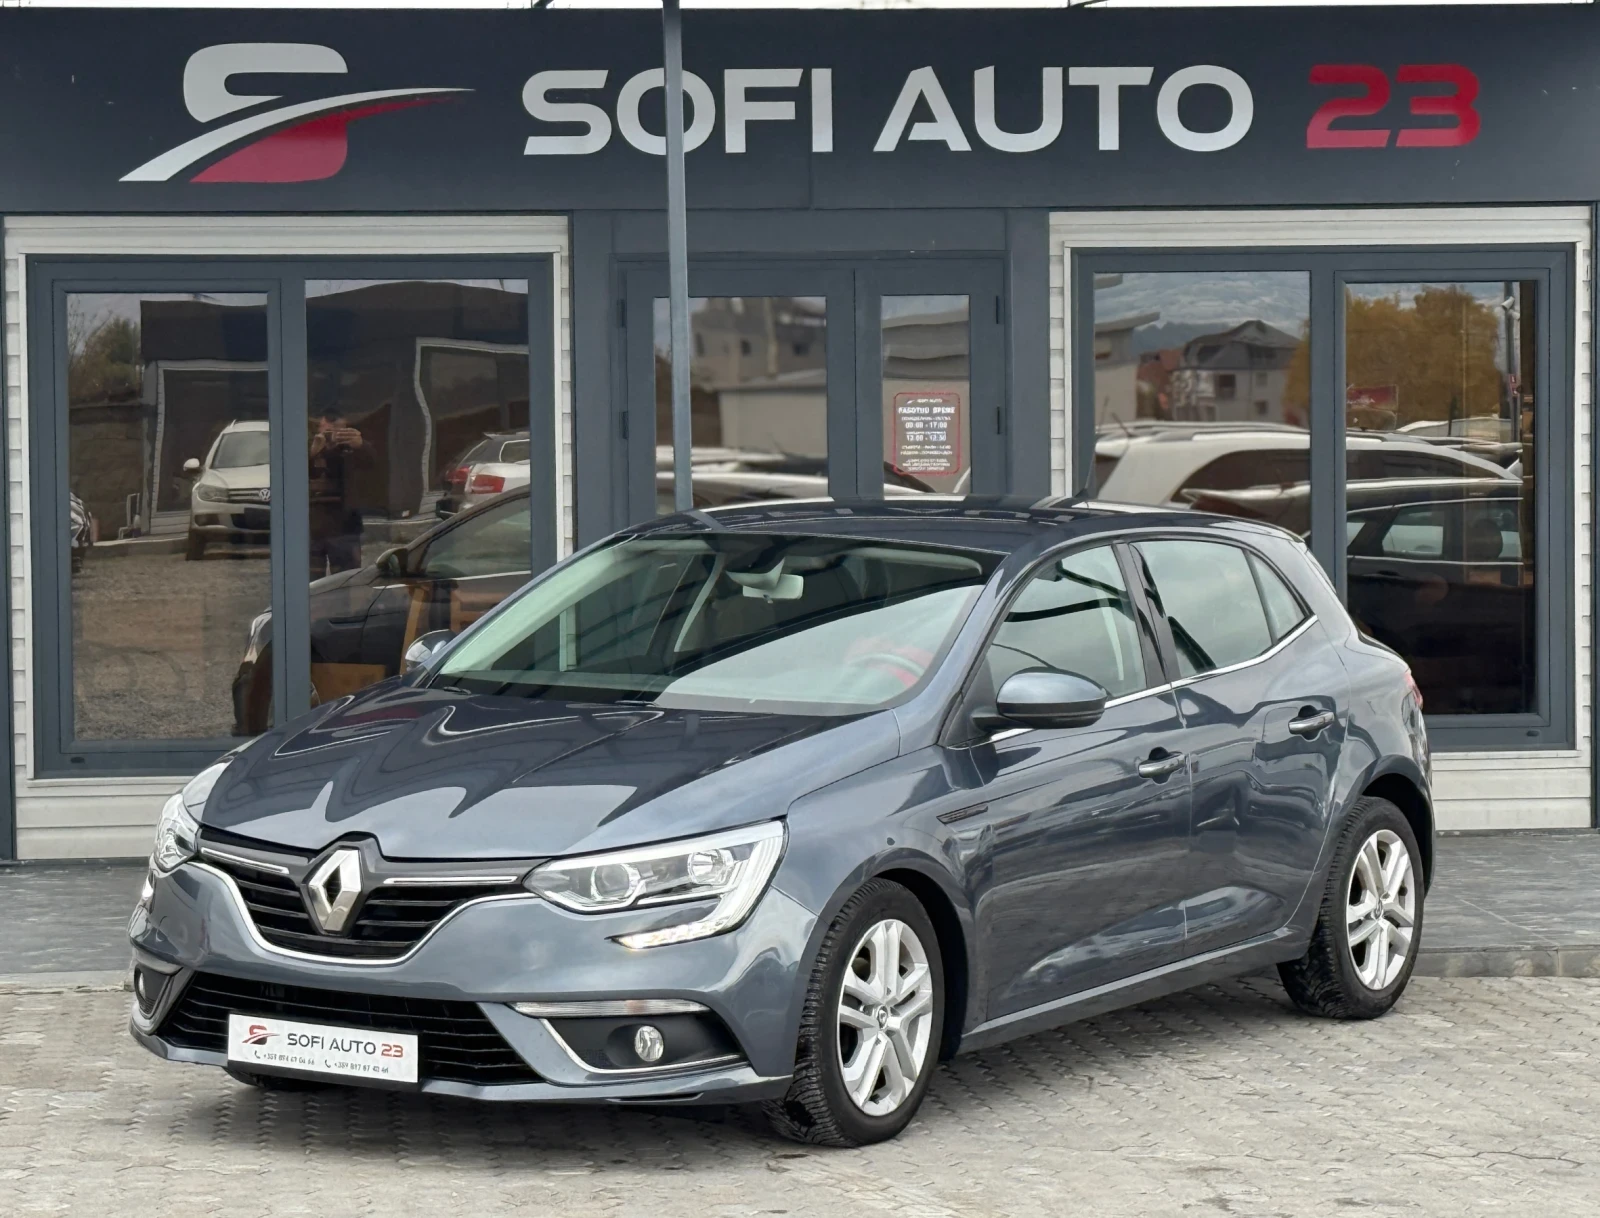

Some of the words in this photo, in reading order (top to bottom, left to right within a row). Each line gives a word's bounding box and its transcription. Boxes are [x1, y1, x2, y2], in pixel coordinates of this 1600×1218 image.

[522, 67, 833, 156] SOFI
[873, 64, 1254, 153] AUTO
[1306, 63, 1481, 149] 23
[287, 1032, 325, 1050] SOFI
[329, 1037, 377, 1055] AUTO
[380, 1043, 404, 1058] 23
